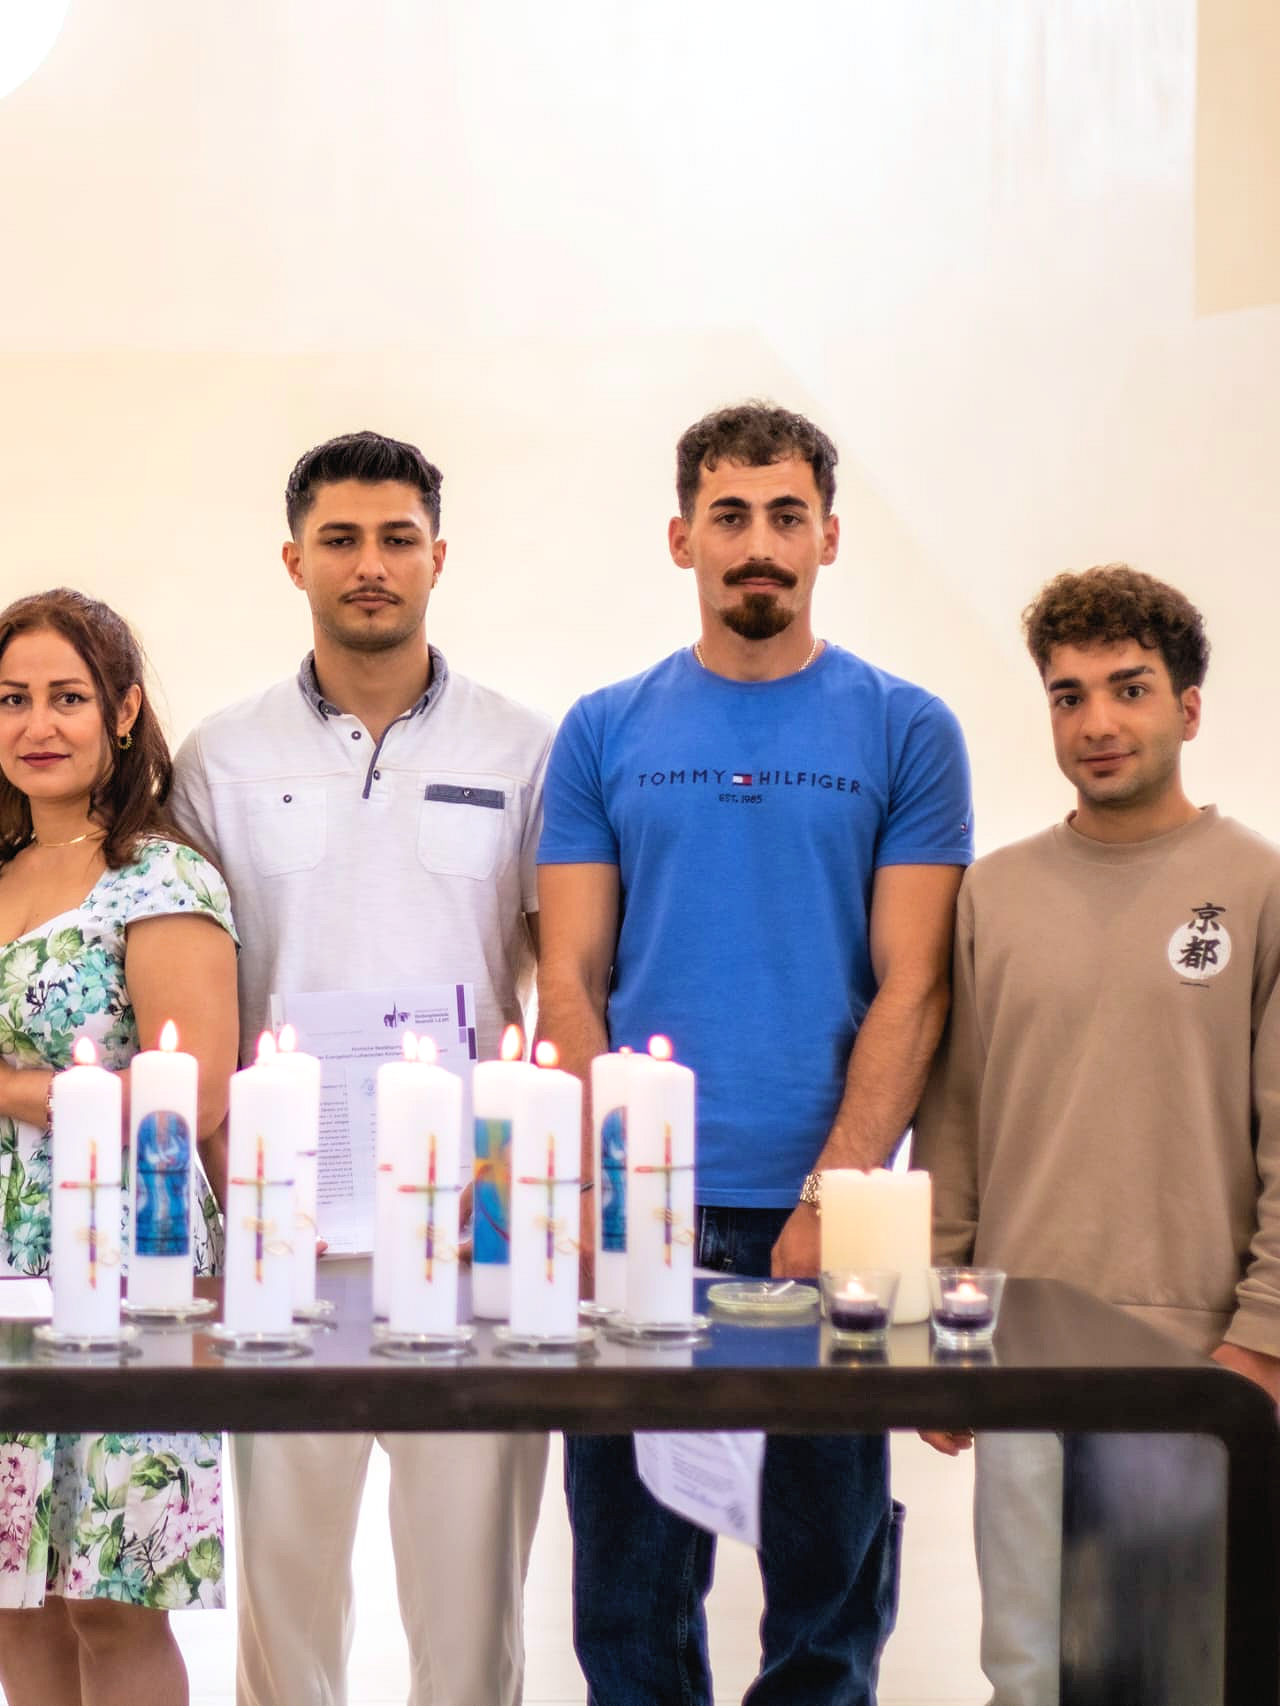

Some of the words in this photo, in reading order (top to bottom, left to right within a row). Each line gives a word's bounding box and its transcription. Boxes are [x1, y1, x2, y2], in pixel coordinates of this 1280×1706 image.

[638, 769, 727, 788] TOMMY
[759, 770, 862, 796] HILFIGER
[719, 793, 739, 804] EST.
[1177, 902, 1226, 971] 京都
